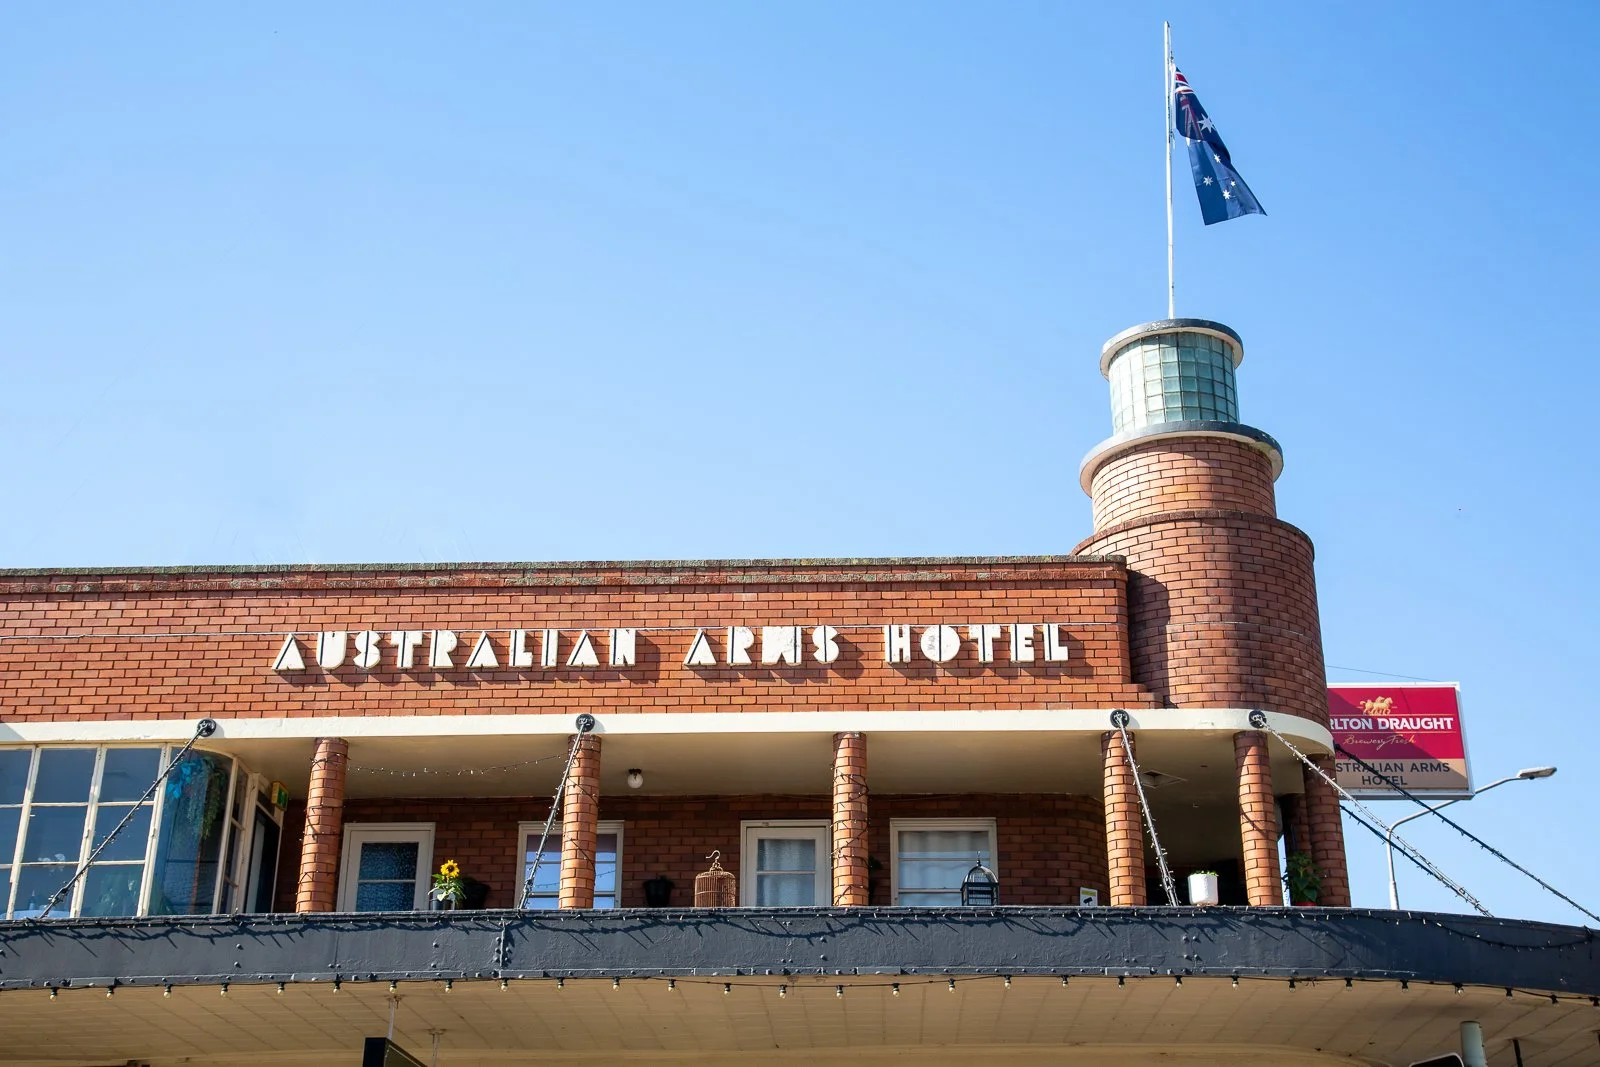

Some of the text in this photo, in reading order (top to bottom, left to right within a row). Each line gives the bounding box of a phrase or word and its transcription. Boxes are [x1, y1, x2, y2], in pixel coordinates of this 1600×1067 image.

[272, 623, 1068, 670] AUSTRALIAN ARMS HOTEL
[1377, 717, 1453, 730] DRAUGHT
[1343, 733, 1416, 751] Brewery Fresh
[1410, 762, 1451, 773] ARMS
